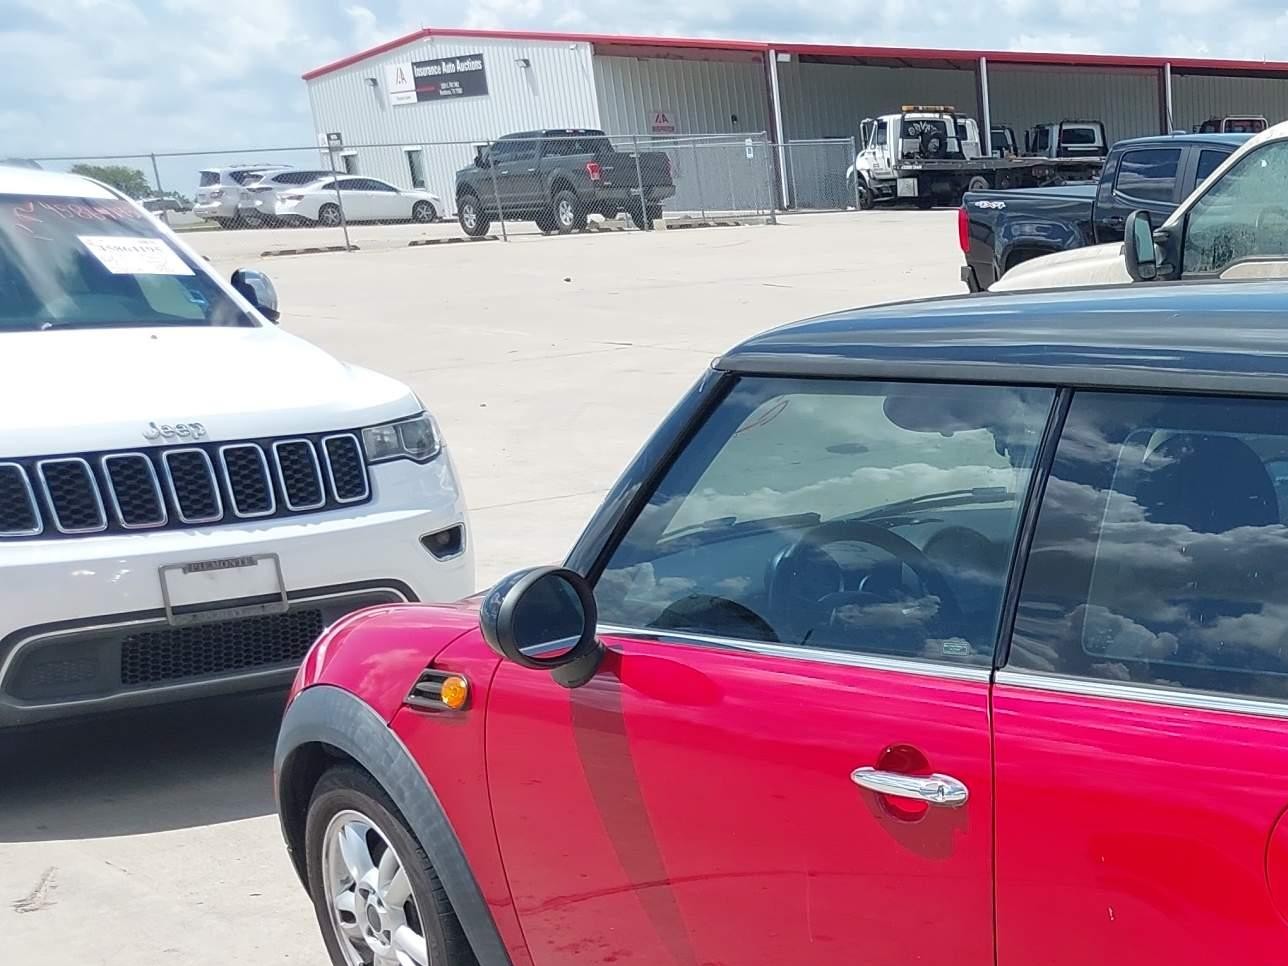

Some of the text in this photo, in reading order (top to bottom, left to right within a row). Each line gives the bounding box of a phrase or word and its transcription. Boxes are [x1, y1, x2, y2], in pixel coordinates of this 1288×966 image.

[414, 57, 483, 77] Insurance Auto Auctions
[142, 421, 207, 441] Jeep
